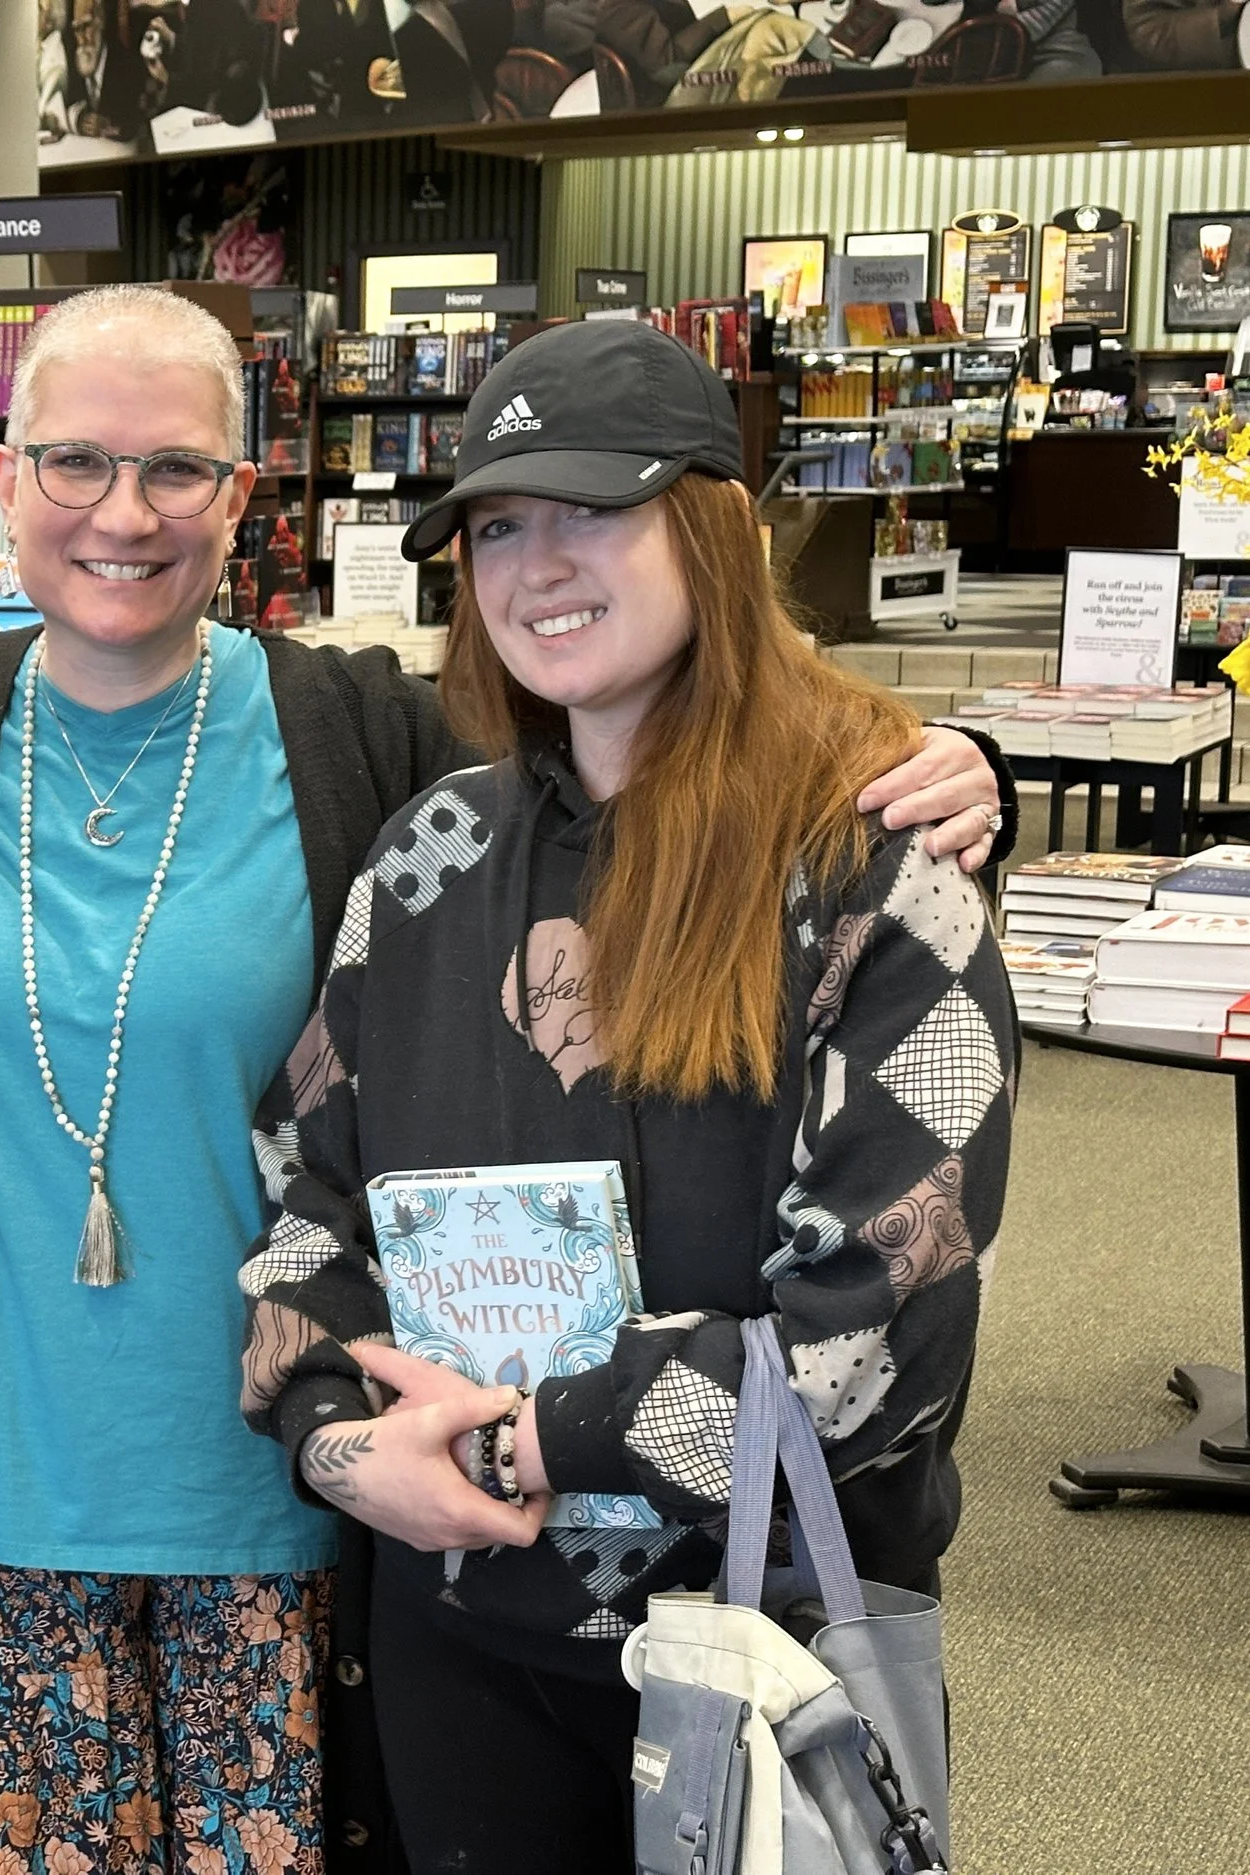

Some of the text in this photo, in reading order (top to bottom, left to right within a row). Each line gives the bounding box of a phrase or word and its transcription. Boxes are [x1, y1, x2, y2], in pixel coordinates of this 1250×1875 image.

[771, 60, 834, 78] NABOKOV
[445, 293, 482, 306] Horror
[487, 416, 542, 442] adidas
[1087, 580, 1163, 592] Run off and join
[1098, 593, 1144, 603] the circus
[1082, 605, 1159, 617] with Scythe and
[1095, 617, 1143, 629] Sparrow!
[471, 1234, 509, 1249] THE
[407, 1255, 591, 1309] PLYMBURY
[438, 1301, 563, 1335] WITCH
